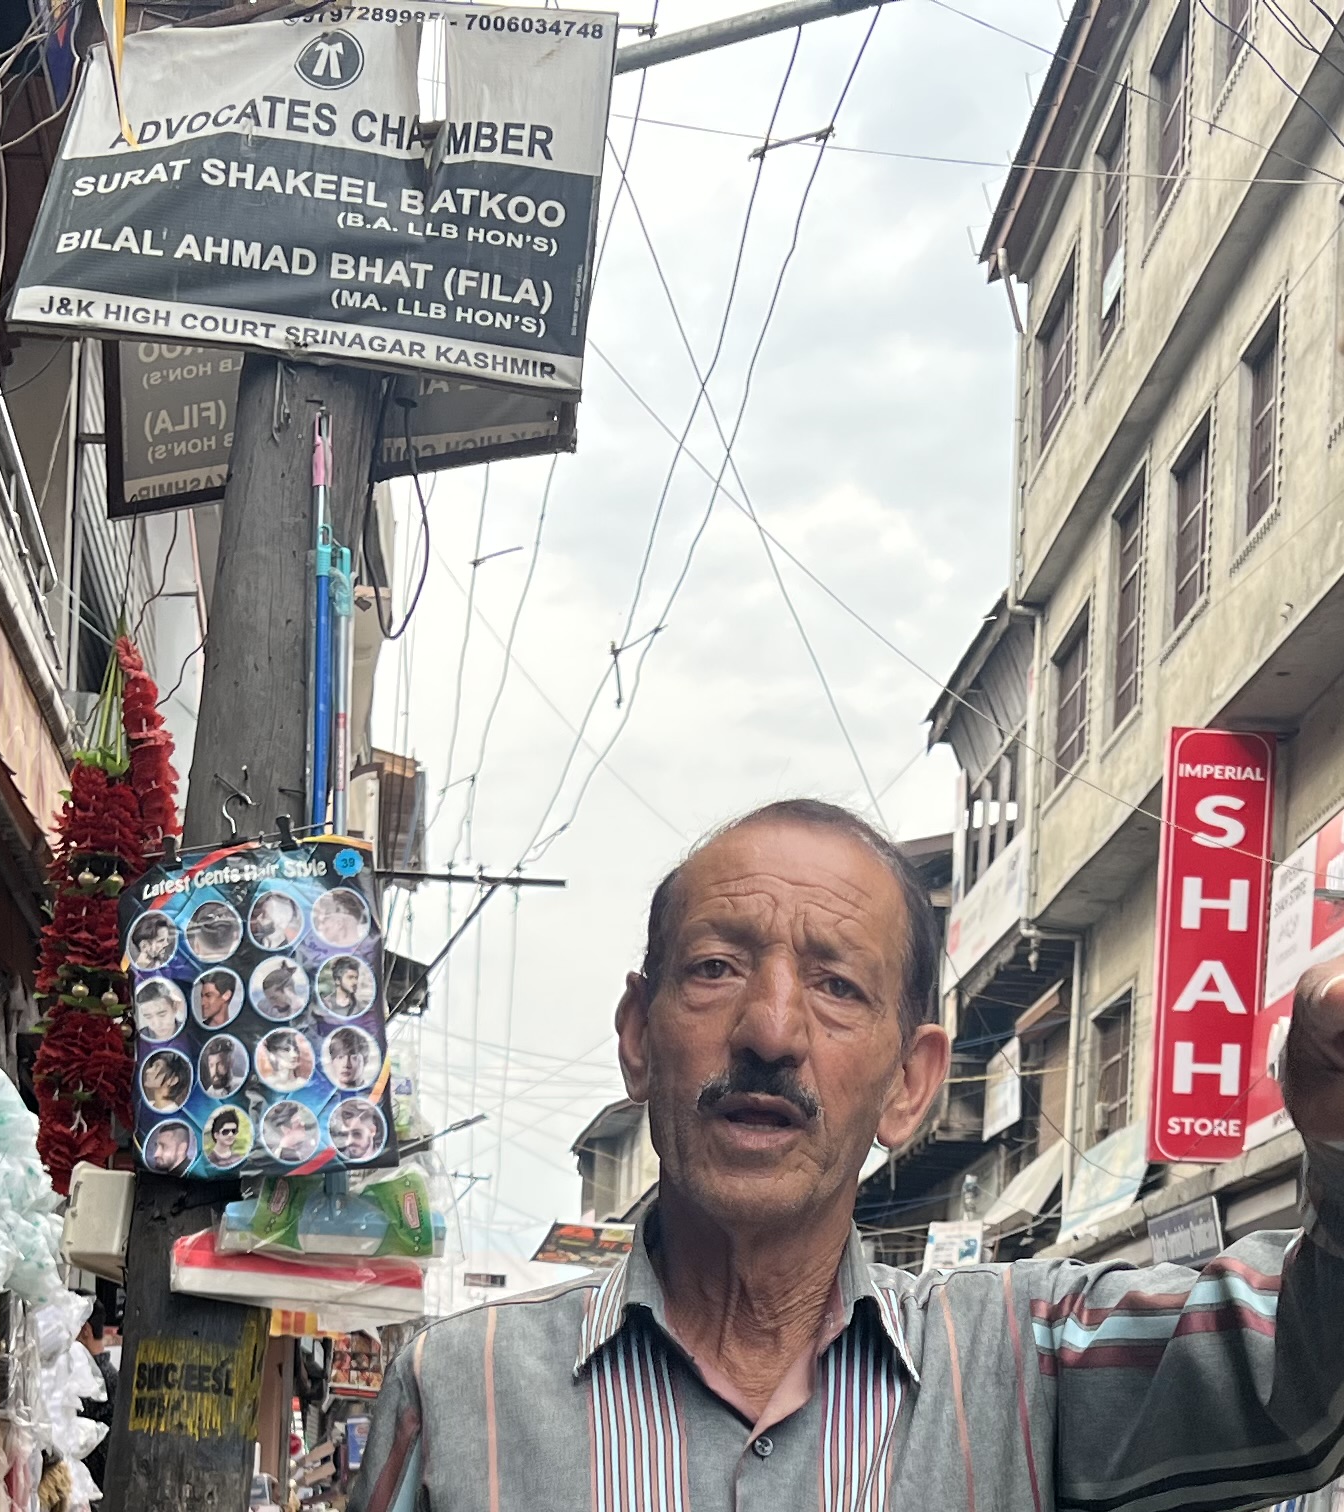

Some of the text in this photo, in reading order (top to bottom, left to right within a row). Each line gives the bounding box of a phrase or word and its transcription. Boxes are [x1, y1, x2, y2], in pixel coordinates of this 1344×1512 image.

[465, 12, 605, 39] 7006034748
[109, 95, 337, 150] ADVOCATES
[72, 157, 566, 228] SURAT SHAKEEL BATKOO
[408, 221, 459, 240] LLB
[467, 227, 558, 257] HON'S)
[56, 225, 164, 256] BILAL
[174, 233, 318, 276] AHMAD
[330, 251, 434, 290] BHAT
[444, 267, 553, 315] (FILA)
[331, 288, 546, 338] (MA. LLB HON'S)
[40, 295, 556, 381] J&K HIGH COURT SRINAGAR KASHMIR
[1178, 762, 1265, 783] IMPERIAL
[141, 873, 191, 900] Latest
[283, 857, 328, 879] Style
[340, 857, 355, 869] 39
[1172, 794, 1250, 1097] SHAH
[1167, 1116, 1241, 1138] STORE
